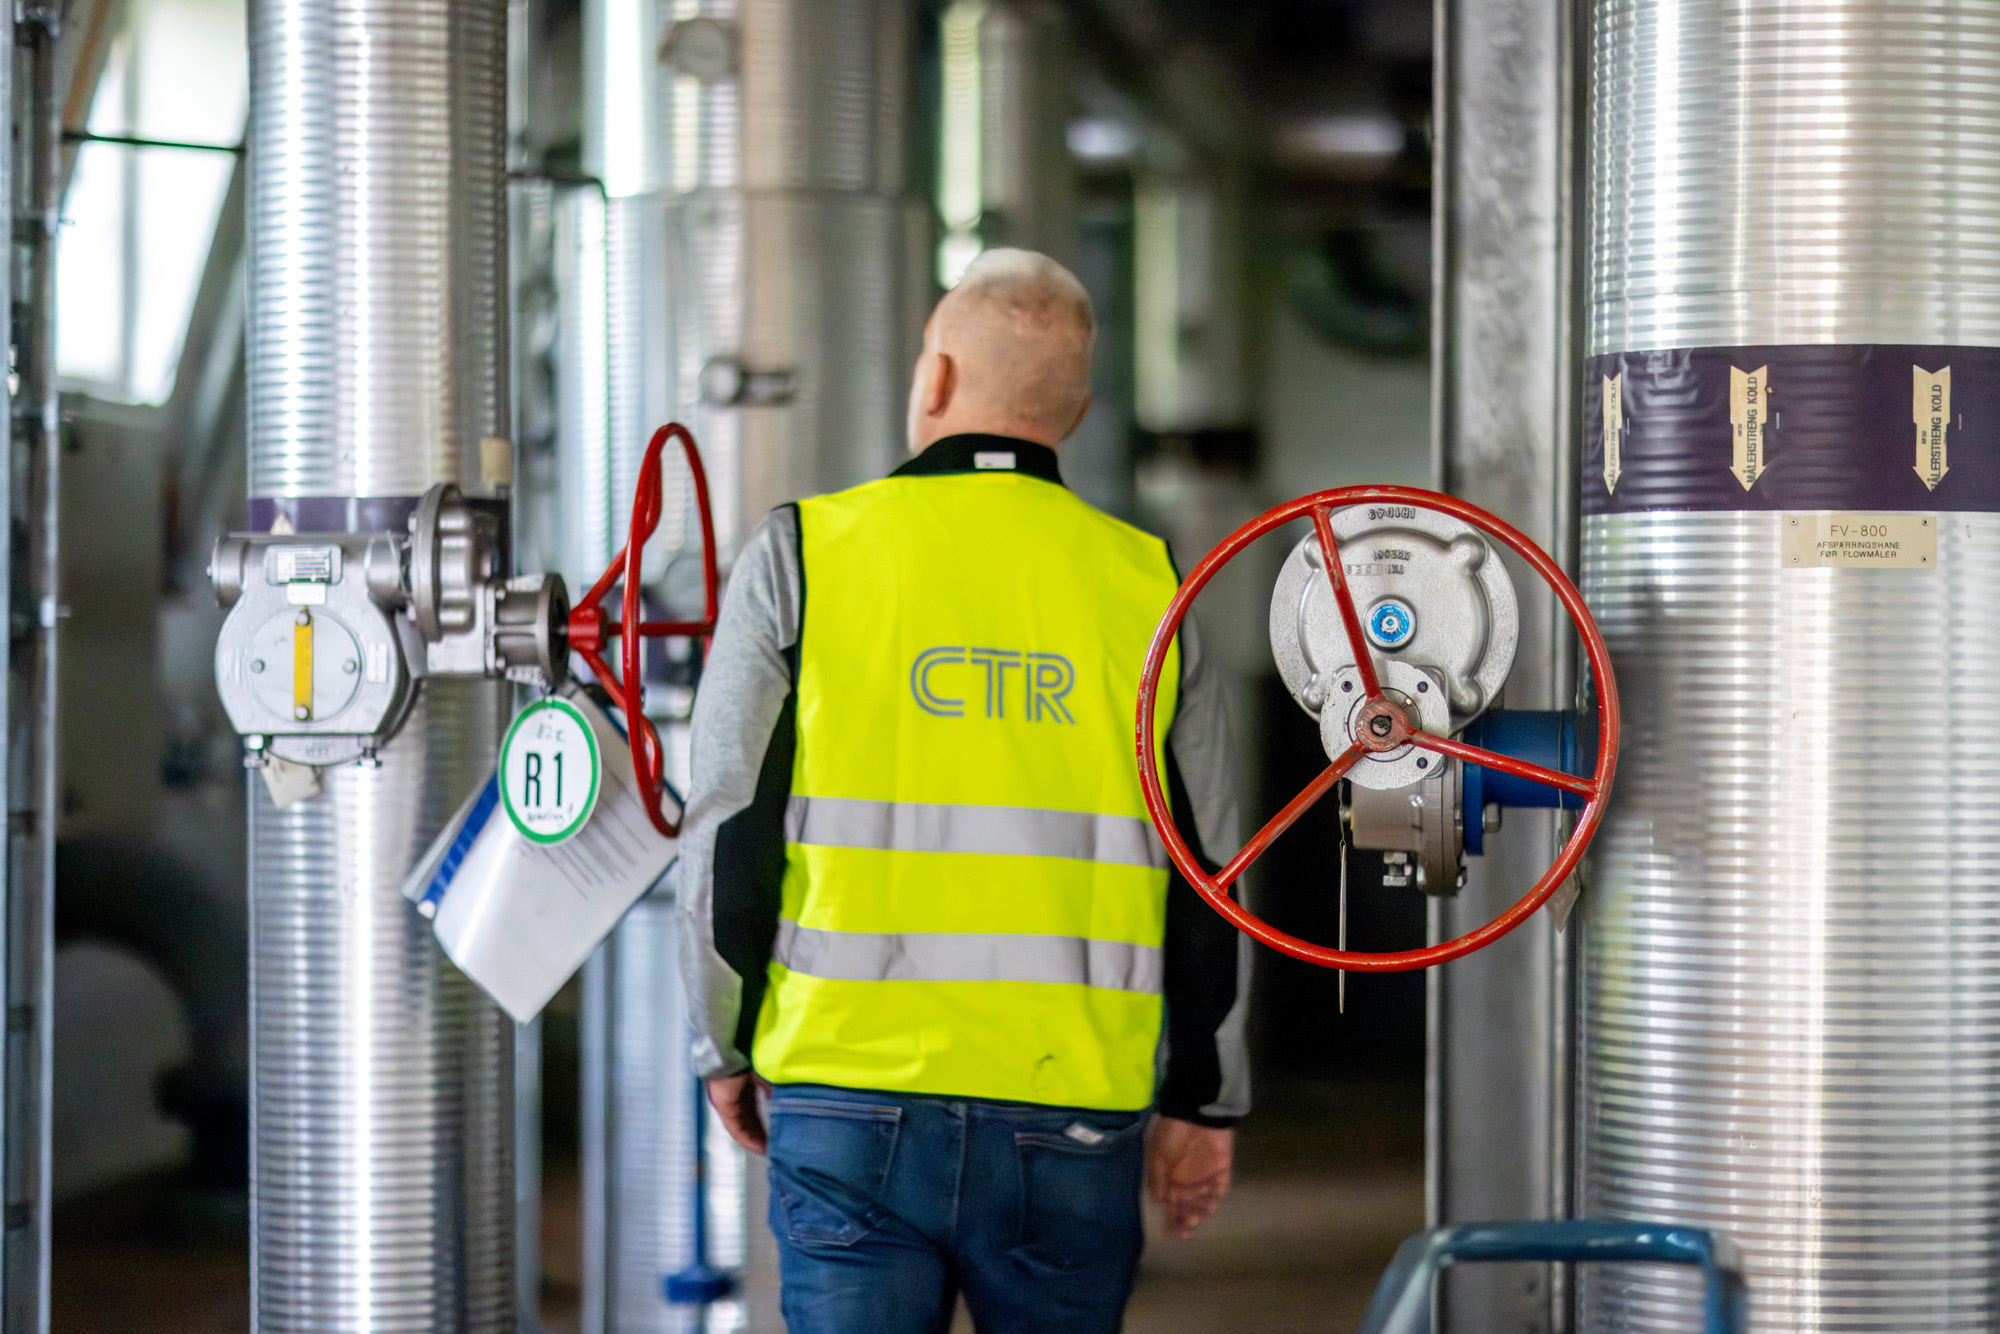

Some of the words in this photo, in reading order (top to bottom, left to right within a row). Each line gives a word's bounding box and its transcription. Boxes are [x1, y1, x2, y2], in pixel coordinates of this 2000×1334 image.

[1746, 376, 1758, 404] KOLD
[1931, 384, 1942, 412] KOLD
[1743, 409, 1758, 483] MÅLERSTRENG
[1830, 525, 1888, 537] FV-800
[1816, 541, 1901, 550] AFSPÆRRINGSHANE
[1820, 550, 1838, 558] FØR
[1842, 550, 1897, 559] FLOWMÅLER
[910, 645, 1077, 725] CTR
